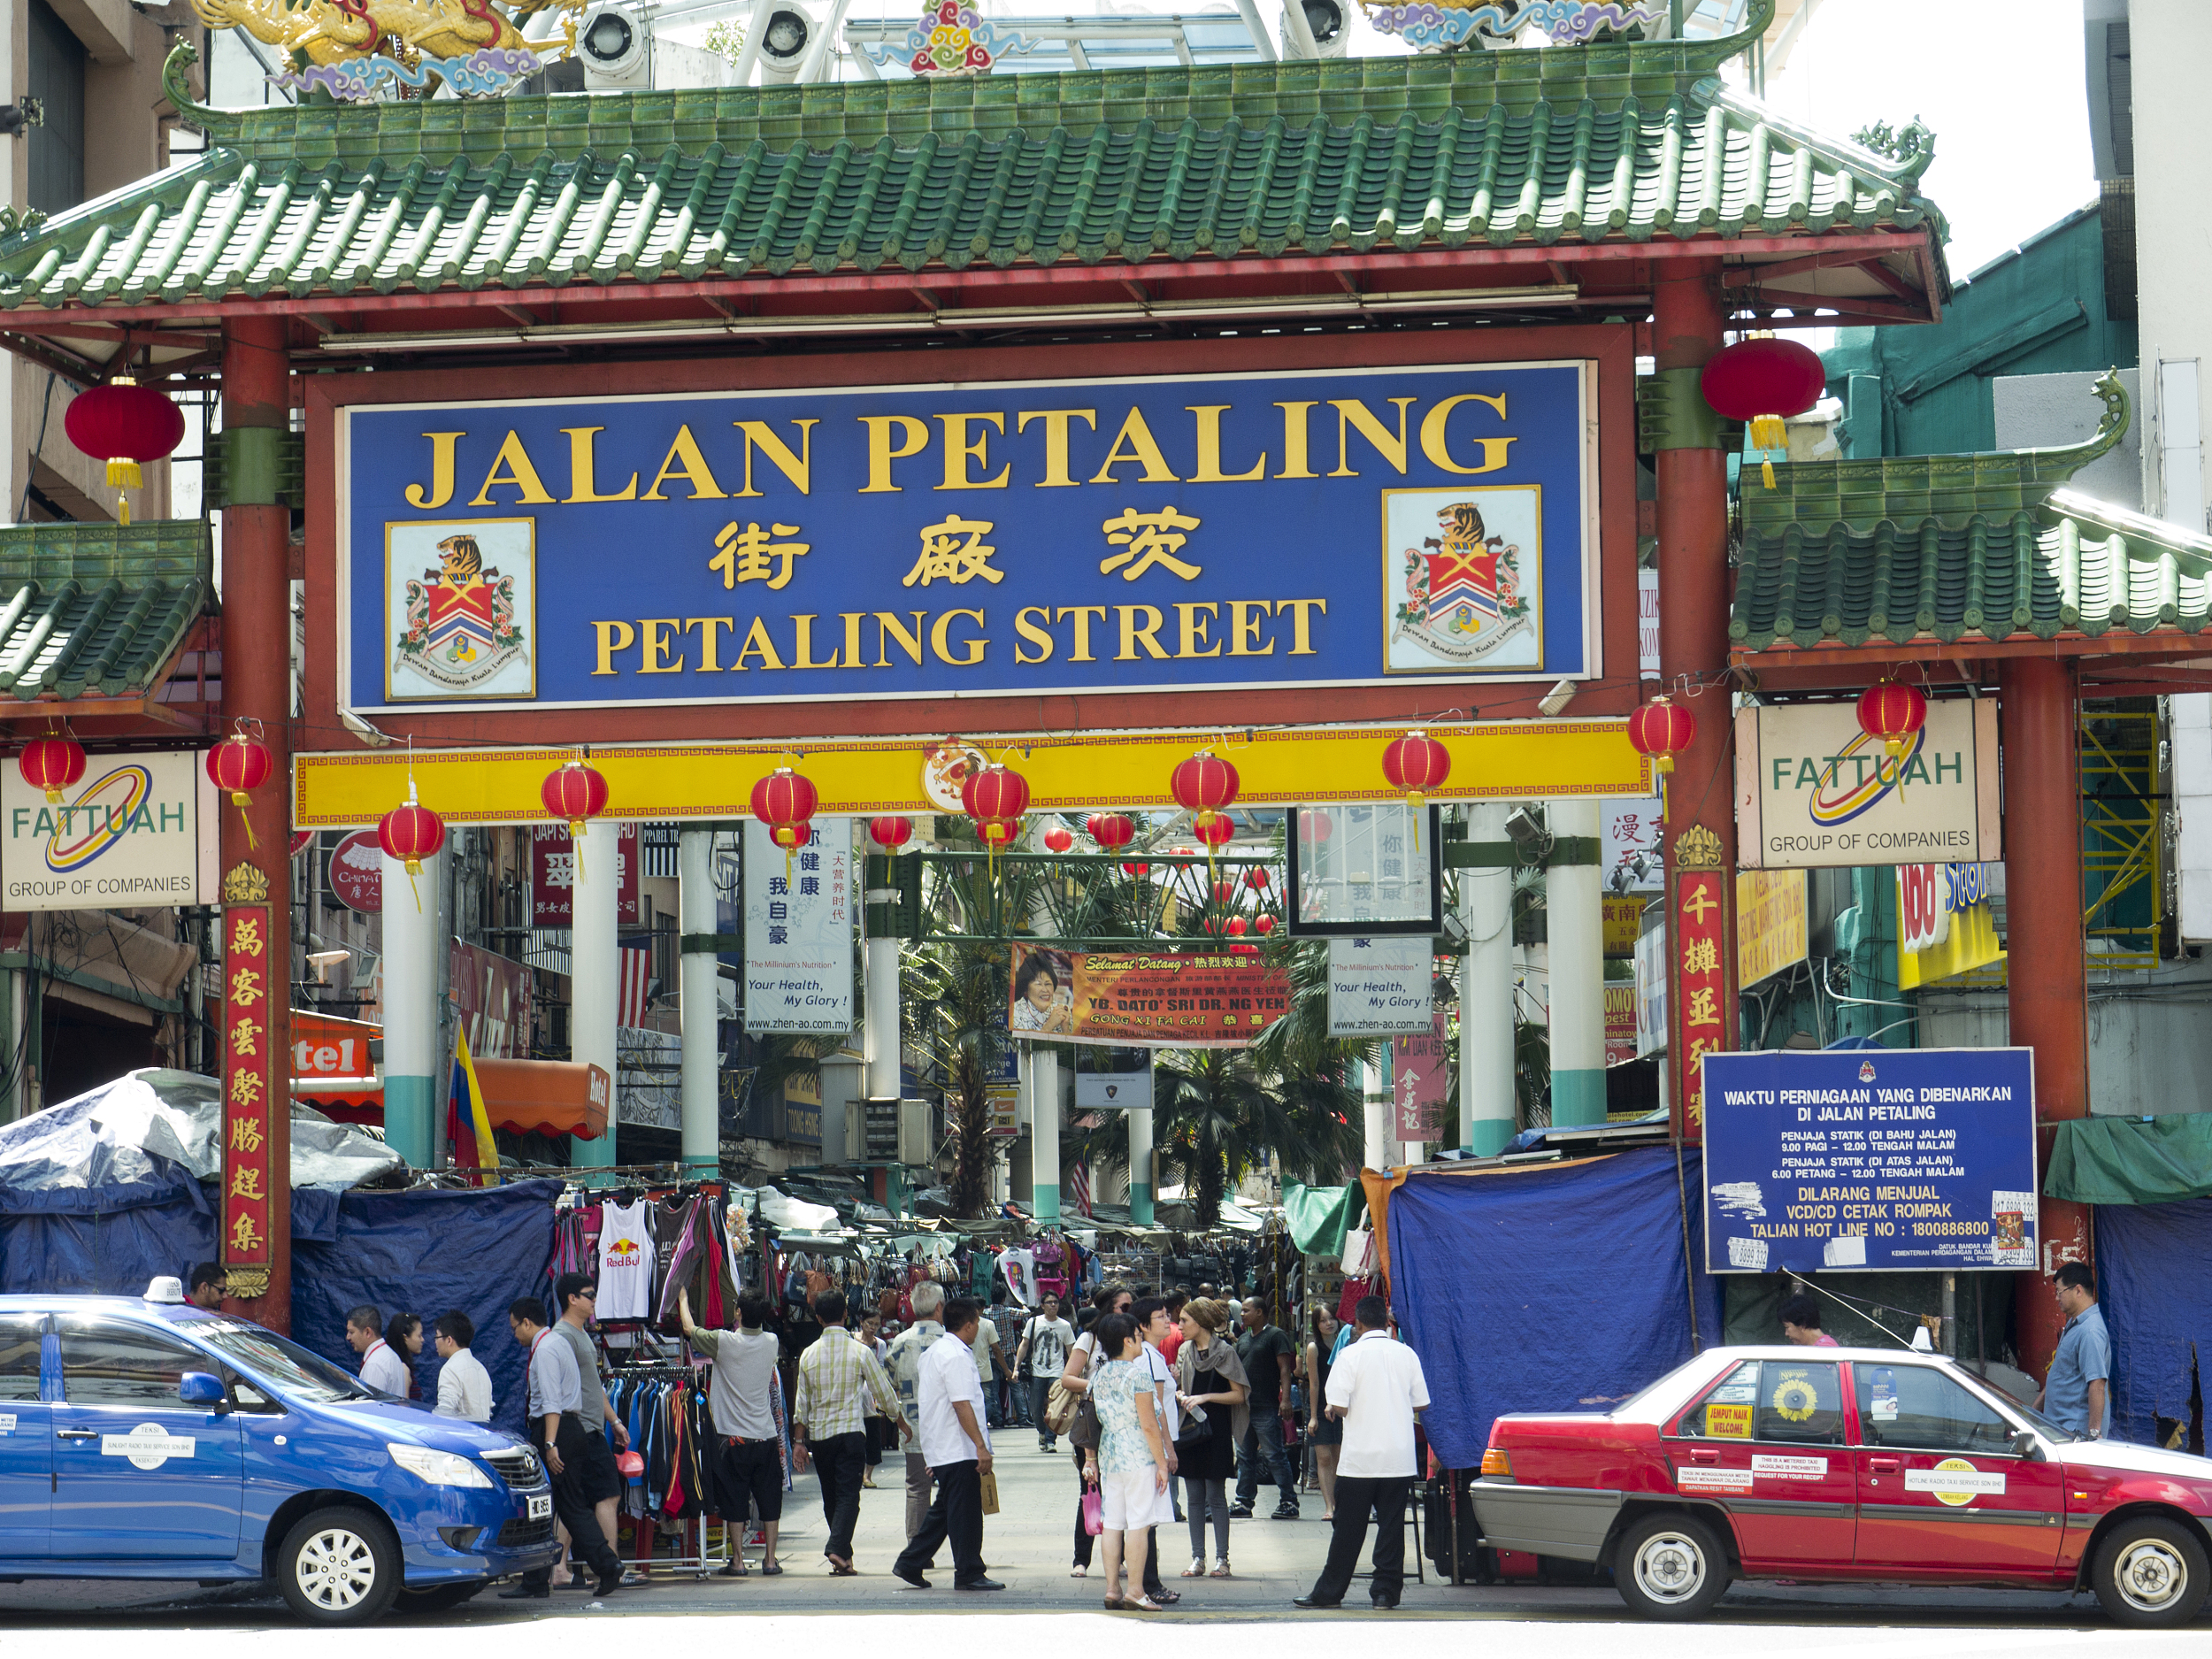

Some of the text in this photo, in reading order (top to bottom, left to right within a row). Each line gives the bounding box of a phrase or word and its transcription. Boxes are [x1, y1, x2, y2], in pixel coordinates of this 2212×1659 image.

[404, 392, 1517, 510] JALAN PETALING
[591, 597, 1326, 675] PETALING STREET
[1402, 617, 1525, 658] Dewan Bandaraya Kuala Lumpur
[403, 646, 520, 687] Dewan Bandaraya Kuala Lumpur
[1772, 751, 1962, 790] FATTUAH
[12, 802, 184, 839] FATTUAH
[1770, 830, 1970, 852] GROUP OF COMPANIES
[9, 876, 191, 897] GROUP OF COMPANIES
[1085, 956, 1183, 974] Selamat Datang
[749, 979, 823, 992] Your Health,
[1333, 981, 1406, 994] Your Health,
[784, 995, 839, 1008] My Glory
[1088, 997, 1285, 1011] YB. DATO' SRI DR. NG YEN
[1368, 996, 1422, 1009] My Glory
[748, 1018, 849, 1032] www.zhen-ao.com.my
[1089, 1013, 1207, 1026] GONG XI FA CAI
[1333, 1018, 1432, 1032] www.zhen-ao.com.my
[1080, 1026, 1115, 1038] PERSATUAN
[590, 1071, 607, 1108] Hotel
[1724, 1087, 2012, 1105] WAKTU PERNIAGAAN YANG DIBENARKAN
[1797, 1105, 1936, 1121] DI JALAN PETALING
[1781, 1129, 1956, 1141] PENJAJA STATIK (DI BAHU JALAN)
[1781, 1141, 1955, 1152] 9.00 PAGI 12.00 TENGAH MALAM
[1781, 1156, 1954, 1167] PENJAJA STATIK (DI ATAS JALAN)
[1771, 1167, 1964, 1179] 6.00 PETANG 12.00 TENGAH MALAM
[1798, 1186, 1940, 1202] DILARANG MENJUAL
[1786, 1203, 1952, 1219] VCD/CD CETAK ROMPAK
[1750, 1221, 1989, 1238] TALIAN HOT LINE NO 1800886800
[606, 1256, 625, 1268] Red
[1710, 1408, 1748, 1420] JEMPUT NAIK
[1713, 1422, 1743, 1434] WELCOME
